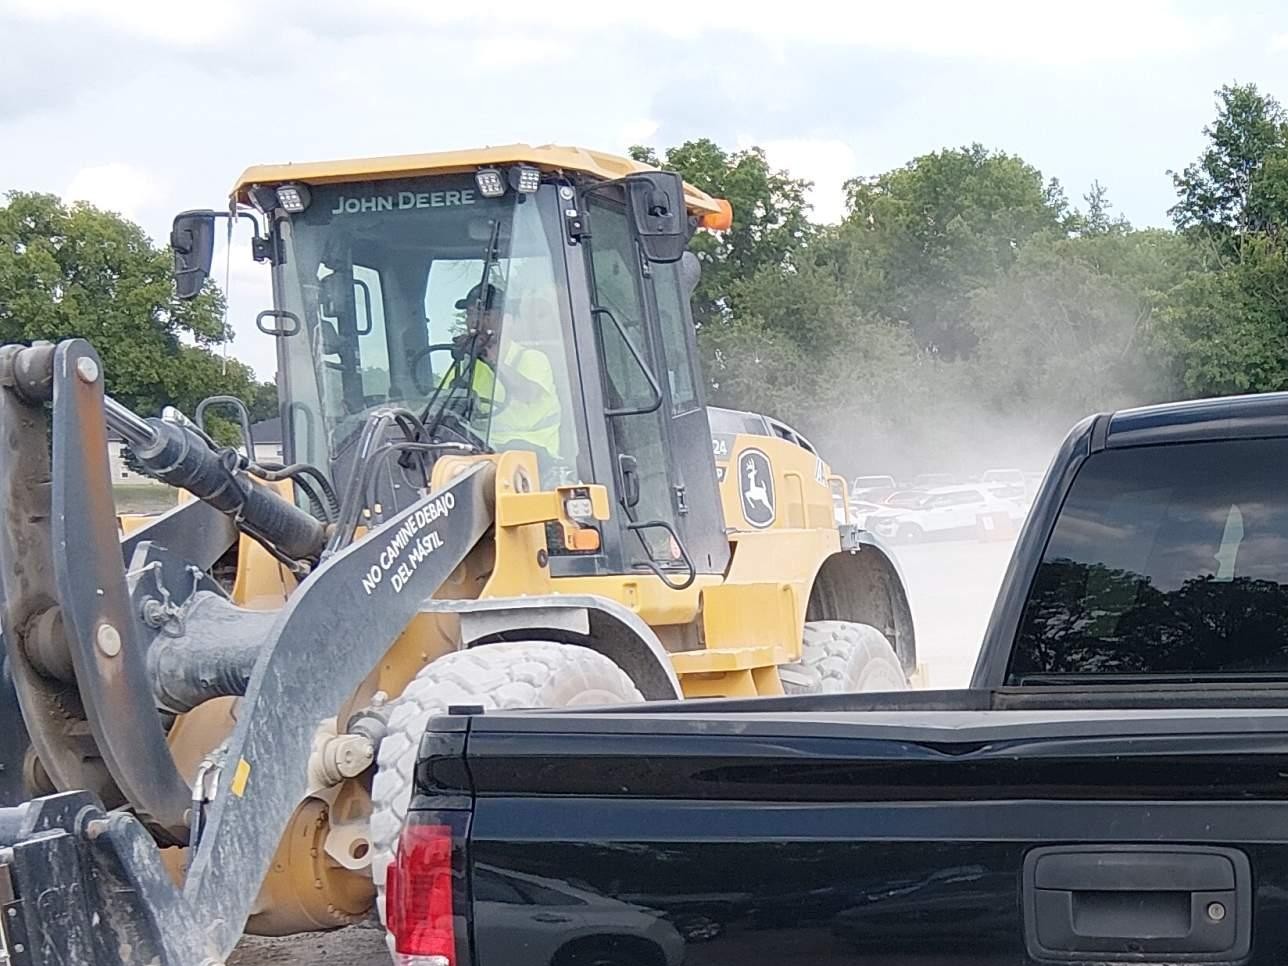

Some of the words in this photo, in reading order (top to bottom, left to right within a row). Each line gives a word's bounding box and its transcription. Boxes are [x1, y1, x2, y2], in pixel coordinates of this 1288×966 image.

[331, 195, 393, 215] JOHN
[398, 190, 476, 209] DEERE
[362, 565, 382, 594] NO
[380, 515, 418, 570] CAMINE
[415, 492, 455, 529] DEBAJO
[391, 562, 414, 593] DEL
[408, 531, 444, 570] MÁSTIL
